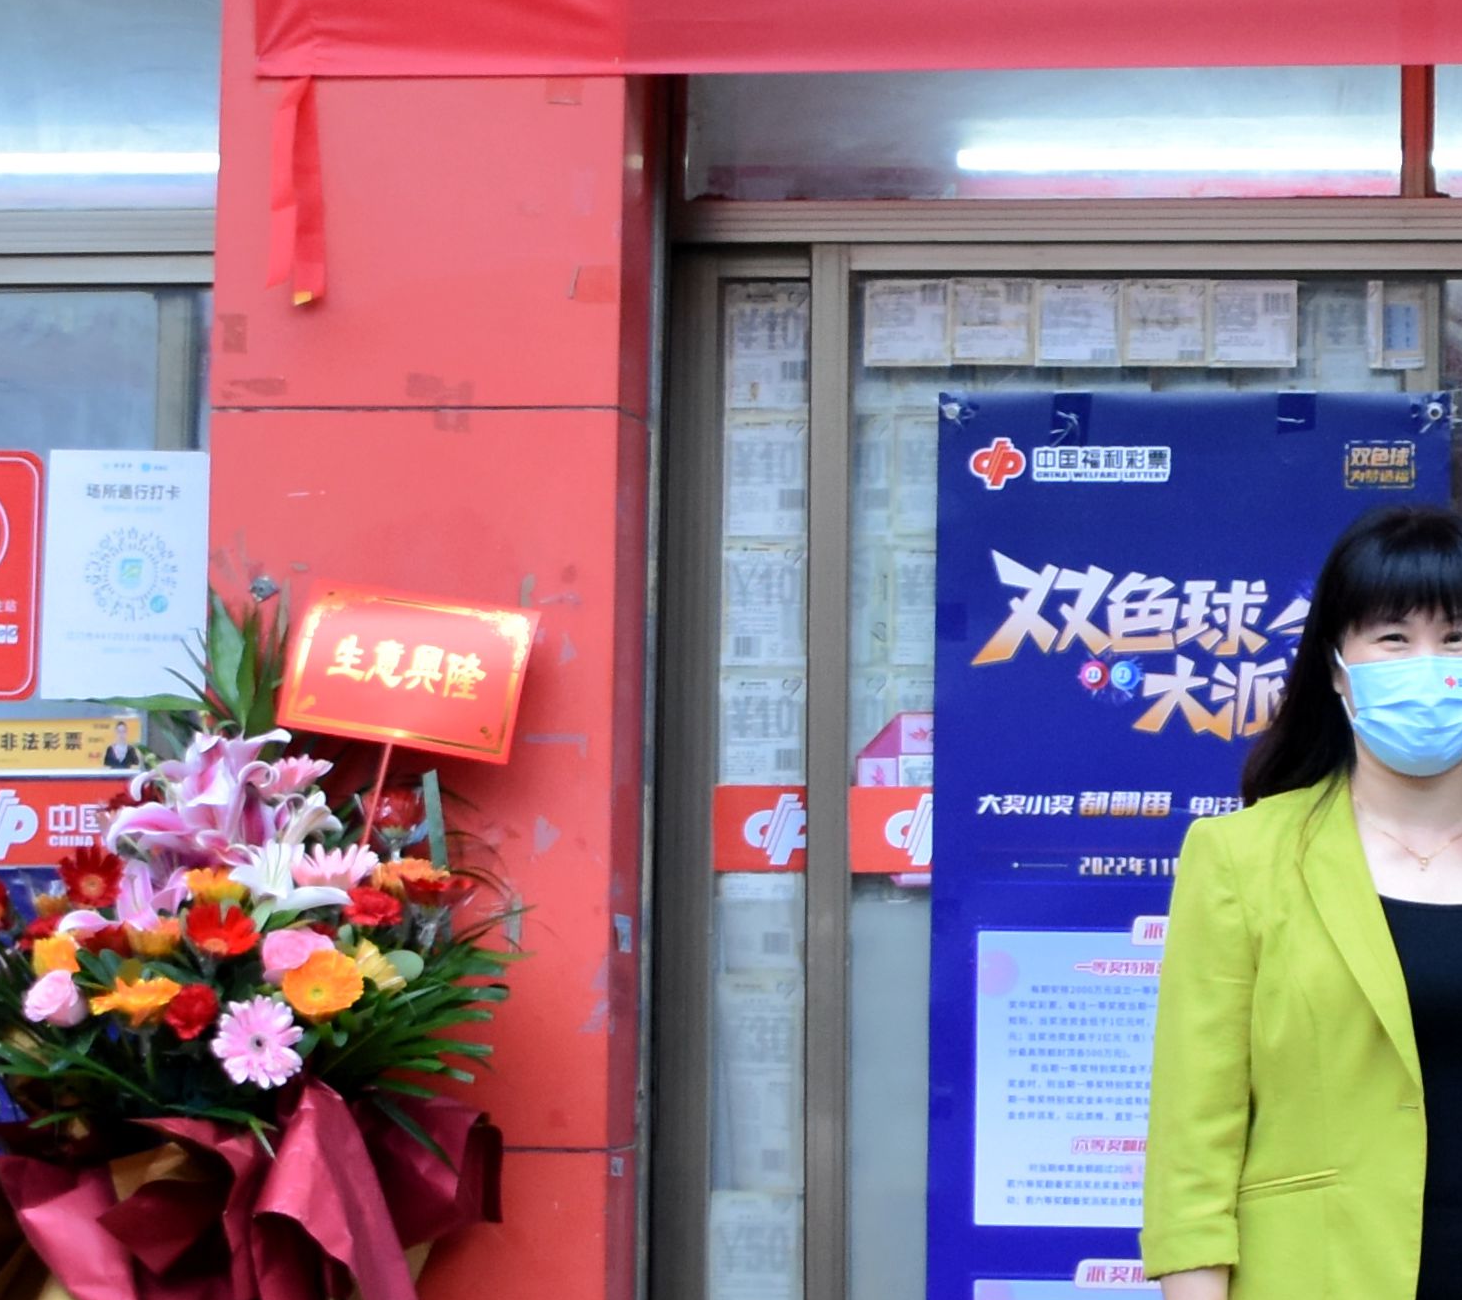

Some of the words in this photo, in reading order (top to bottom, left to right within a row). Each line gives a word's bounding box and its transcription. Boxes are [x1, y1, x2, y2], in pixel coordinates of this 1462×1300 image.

[1035, 448, 1169, 470] 中国福利彩票
[976, 794, 1075, 816] 大奖小奖
